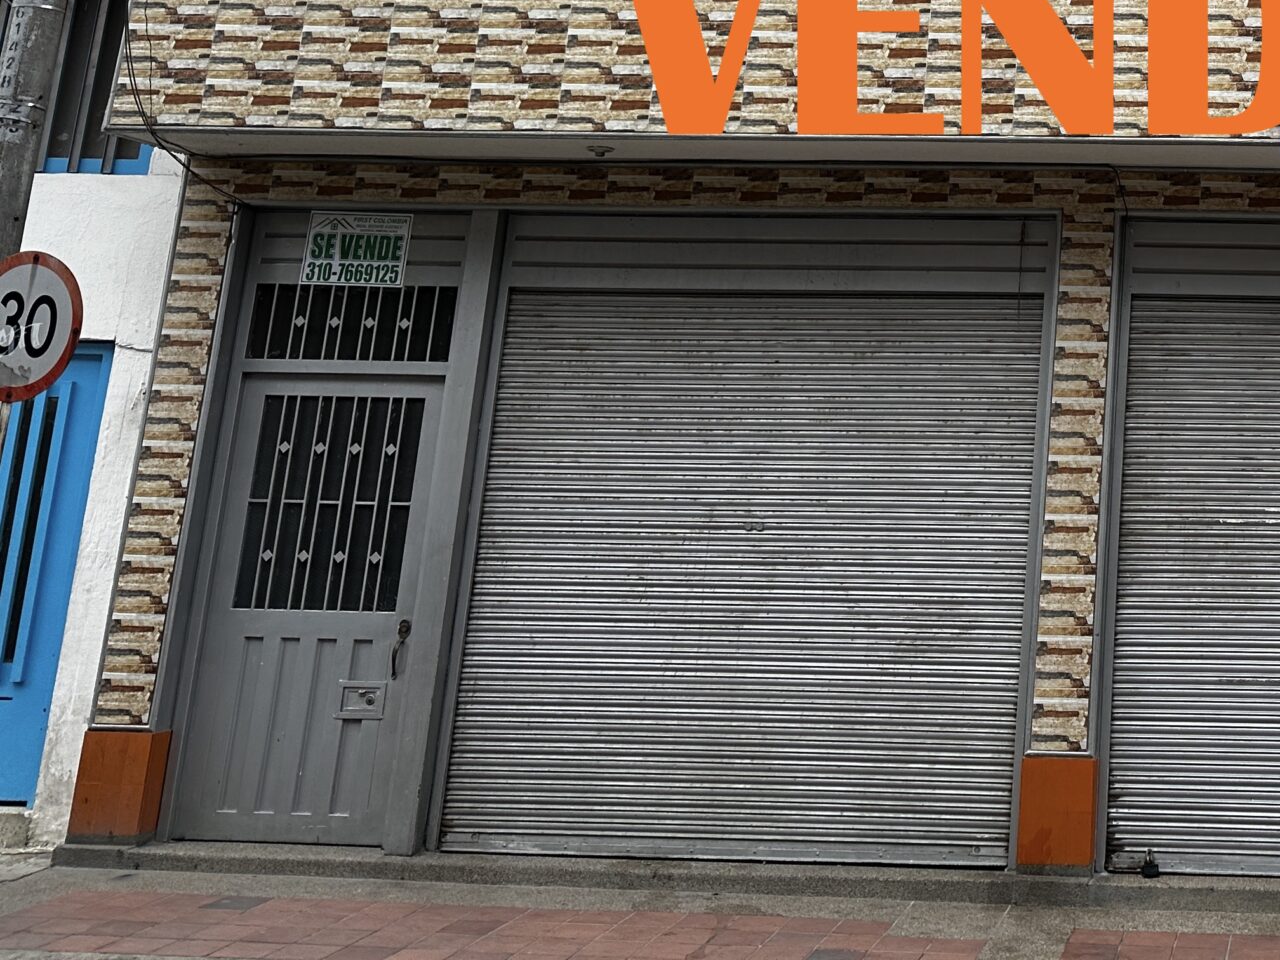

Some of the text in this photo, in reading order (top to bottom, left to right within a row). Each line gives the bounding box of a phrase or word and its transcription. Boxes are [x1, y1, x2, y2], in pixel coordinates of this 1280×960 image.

[310, 232, 403, 261] SE VENDE
[305, 261, 399, 284] 310-7669125
[0, 290, 57, 359] 30
